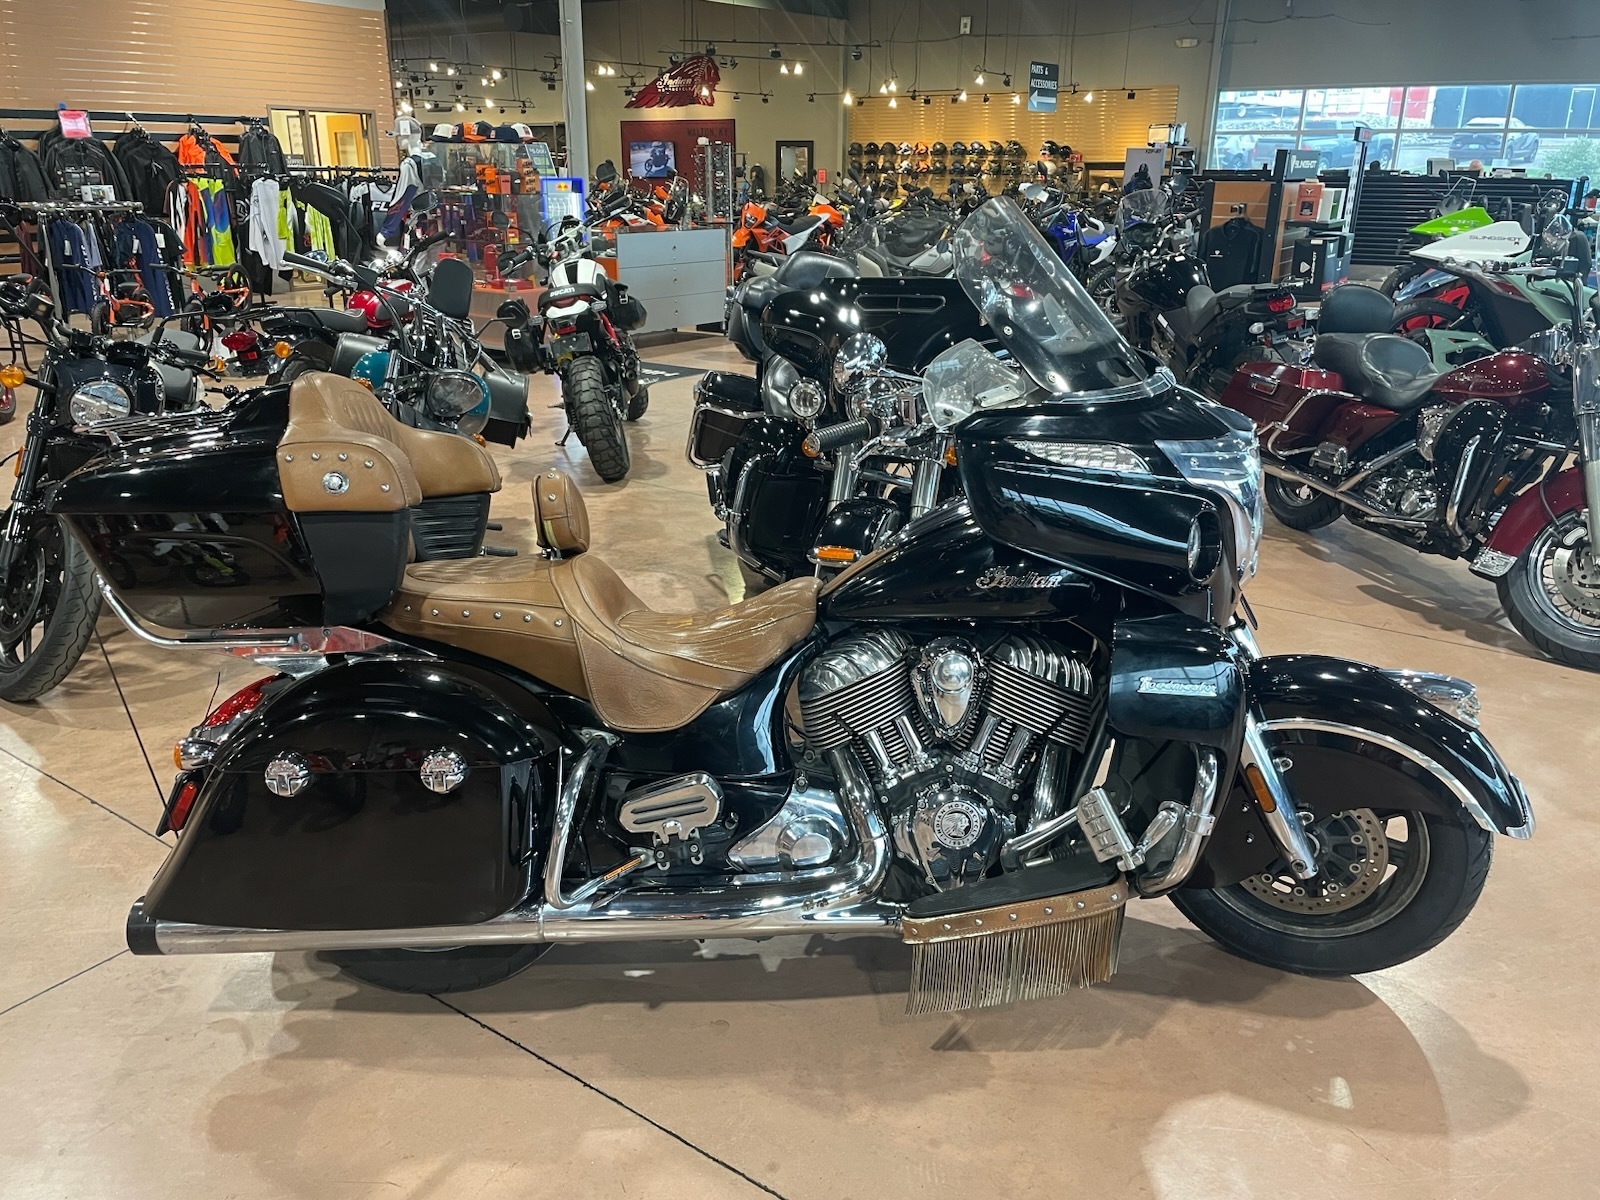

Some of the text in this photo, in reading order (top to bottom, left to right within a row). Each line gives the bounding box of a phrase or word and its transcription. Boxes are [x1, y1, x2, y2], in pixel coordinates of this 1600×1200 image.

[1031, 64, 1043, 74] PARTS
[656, 73, 692, 88] Indian
[1031, 79, 1057, 89] ACCESSORIES
[371, 201, 389, 211] FL
[550, 287, 575, 297] DUCATI
[975, 565, 1063, 589] Indian
[936, 803, 979, 837] INDIAN MOTORCYCLE
